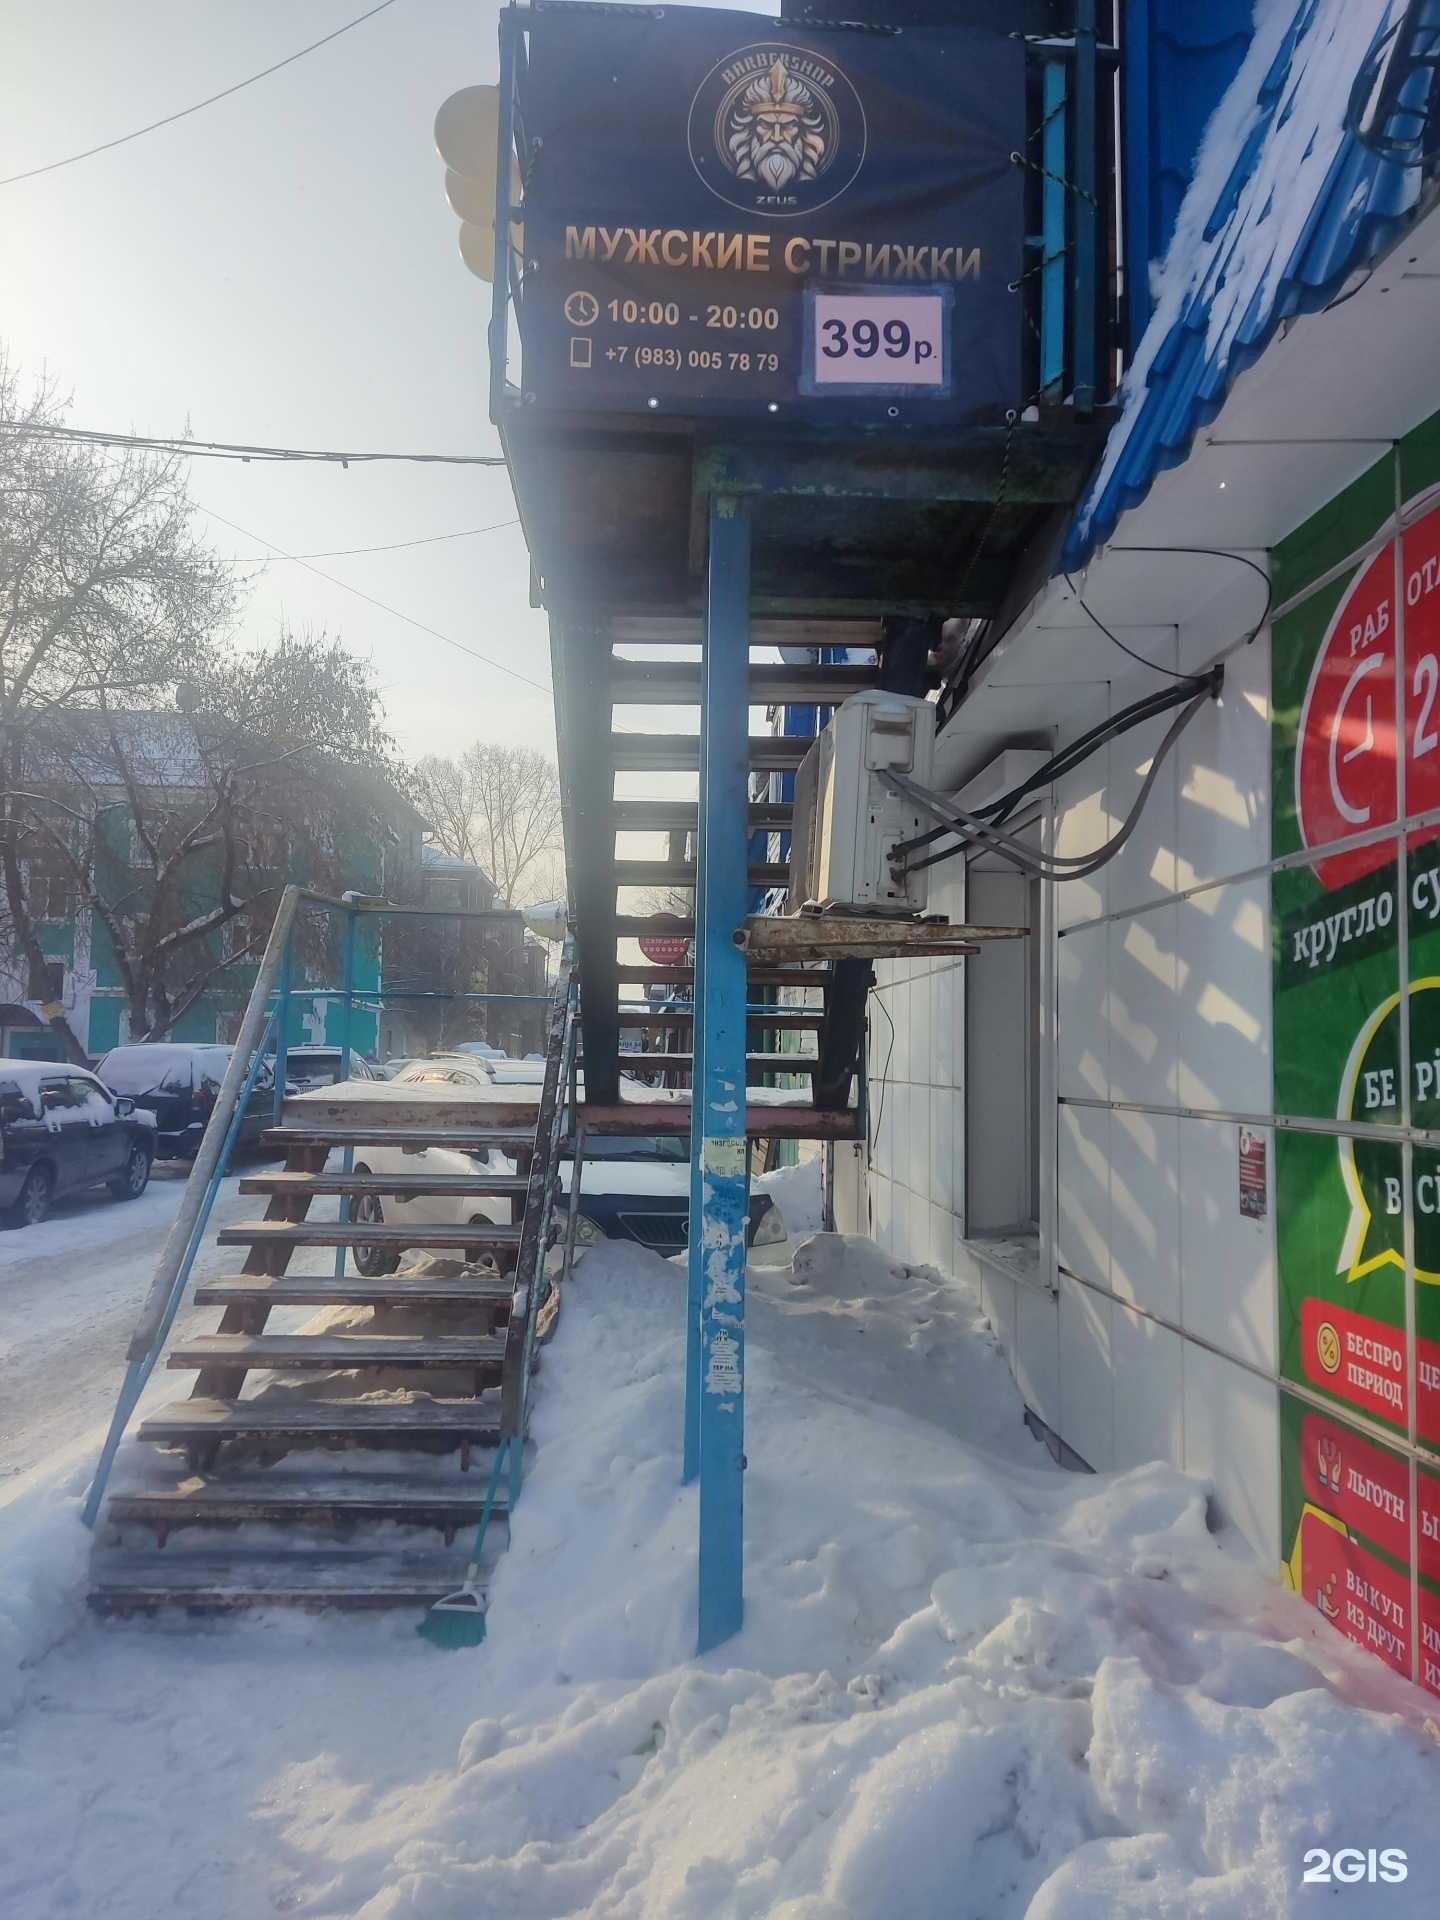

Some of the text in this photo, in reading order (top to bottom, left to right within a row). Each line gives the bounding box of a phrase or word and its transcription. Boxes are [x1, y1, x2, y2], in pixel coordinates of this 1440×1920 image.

[721, 52, 835, 88] BARBERSHOP
[756, 195, 798, 205] ZEUS
[565, 225, 981, 280] МУЖСКИЕ СТРИЖКИ
[607, 299, 680, 325] 10:00
[706, 304, 779, 330] 20:00
[605, 346, 779, 372] +7 (983) 005 78 79
[821, 318, 938, 365] 399р.
[1347, 1362, 1403, 1411] ПЕРИОД
[1346, 1567, 1404, 1630] ВЫКУП
[1346, 1599, 1365, 1631] ИЗ
